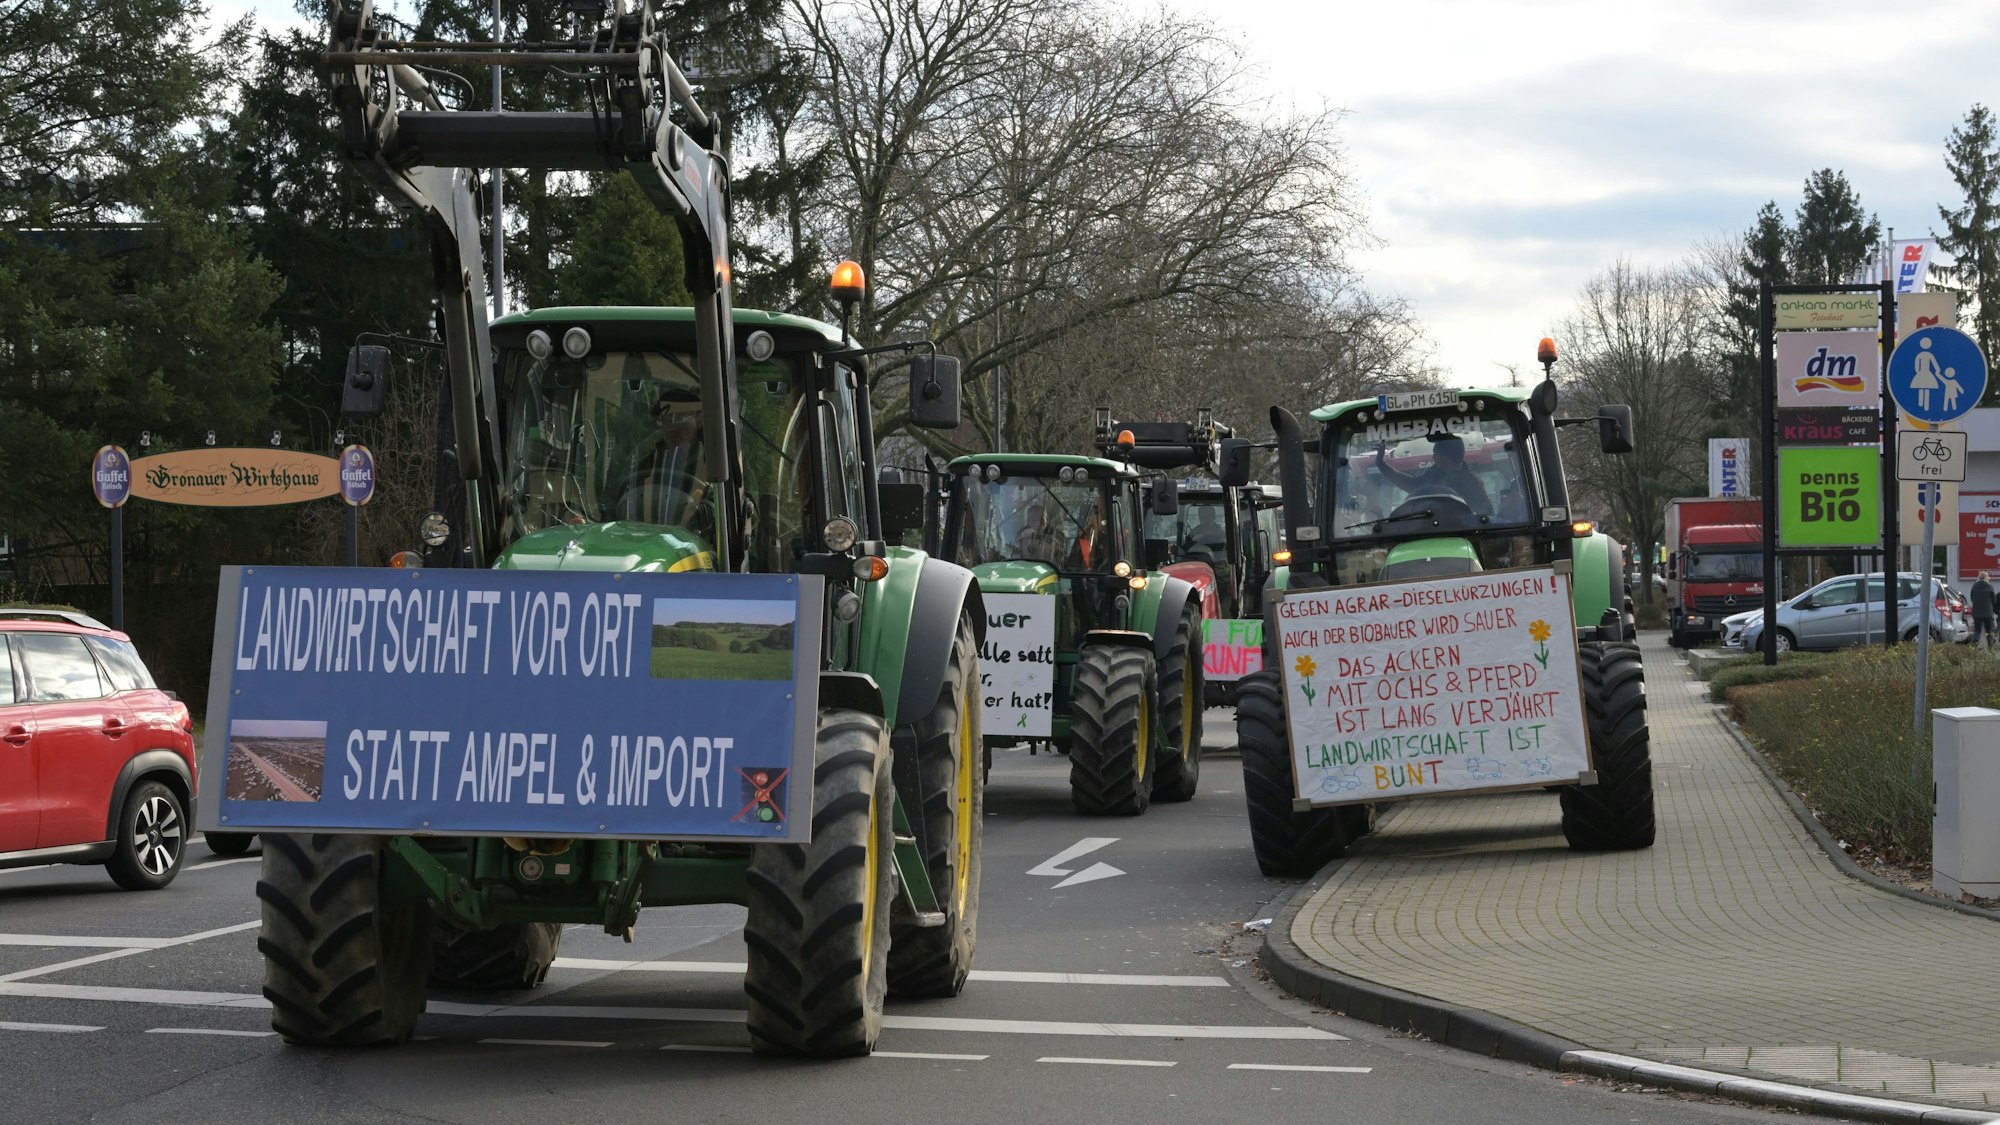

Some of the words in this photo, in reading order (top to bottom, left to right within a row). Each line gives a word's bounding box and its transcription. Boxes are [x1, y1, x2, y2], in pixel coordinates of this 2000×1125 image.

[1781, 300, 1827, 310] ankara
[1831, 300, 1874, 310] markt
[1806, 348, 1856, 377] dm
[1387, 397, 1401, 409] GL
[1410, 394, 1425, 407] PM
[1429, 391, 1457, 405] 6150
[1366, 416, 1480, 441] MIEBACH
[1849, 427, 1866, 435] CAFÉ
[96, 470, 128, 483] Gaffel
[230, 461, 319, 491] Wirtshaus
[341, 469, 371, 481] Gaffel
[1921, 464, 1942, 476] frei
[988, 613, 1031, 629] uer
[1280, 600, 1329, 618] GEGEN
[236, 587, 501, 675] LANDWIRTSCHAFT
[510, 590, 571, 677] VOR
[579, 593, 642, 678] ORT
[1284, 630, 1318, 649] AUCH
[1324, 628, 1346, 645] DER
[1350, 619, 1417, 644] BIOBAUER
[1422, 614, 1459, 636] WIRD
[1464, 607, 1517, 633] SAUER
[1018, 645, 1053, 664] satt
[1338, 656, 1375, 678] DAS
[1383, 645, 1461, 675] ACKERN
[1327, 682, 1367, 708] MIT
[1377, 673, 1438, 701] OCHS
[1445, 671, 1463, 693] &
[1468, 663, 1537, 694] PFERD
[1011, 691, 1052, 710] hat!
[1335, 708, 1370, 733] IST
[1382, 703, 1437, 729] LANG
[1451, 690, 1559, 726] VERJÄHRT
[1306, 729, 1490, 769] LANDWIRTSCHAFT
[1508, 724, 1547, 751] IST
[343, 729, 450, 802] STATT
[456, 732, 565, 805] AMPEL
[576, 734, 597, 805] &
[606, 735, 734, 808] IMPORT
[1373, 760, 1443, 791] BUNT
